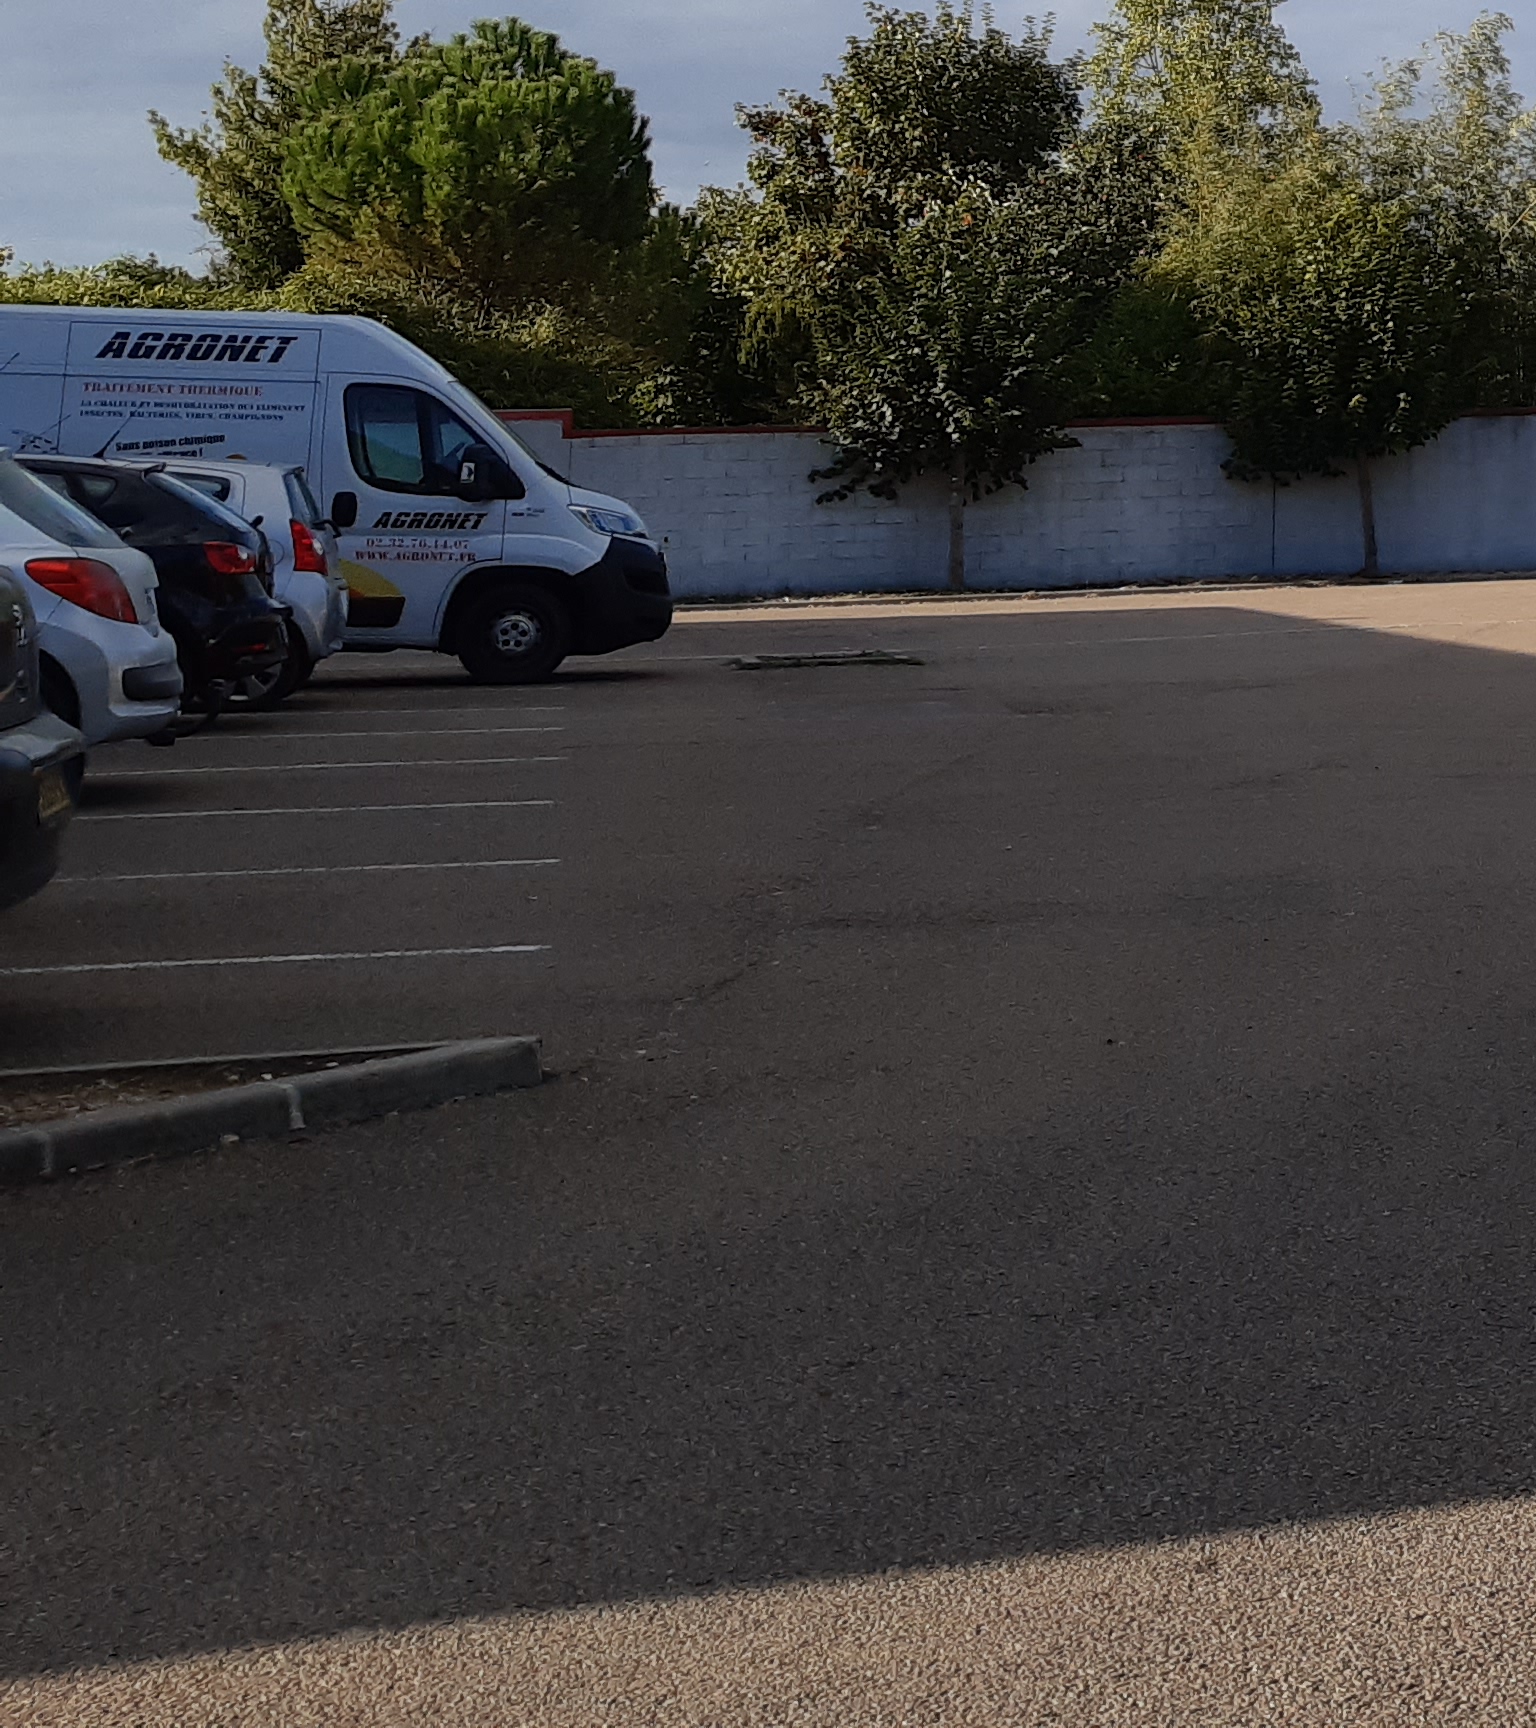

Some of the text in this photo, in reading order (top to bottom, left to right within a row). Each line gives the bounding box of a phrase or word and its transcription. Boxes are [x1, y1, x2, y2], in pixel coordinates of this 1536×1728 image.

[95, 330, 298, 363] AGRONET
[83, 382, 263, 397] TRAITEMENT THERMIQUE
[372, 511, 488, 530] AGRONET
